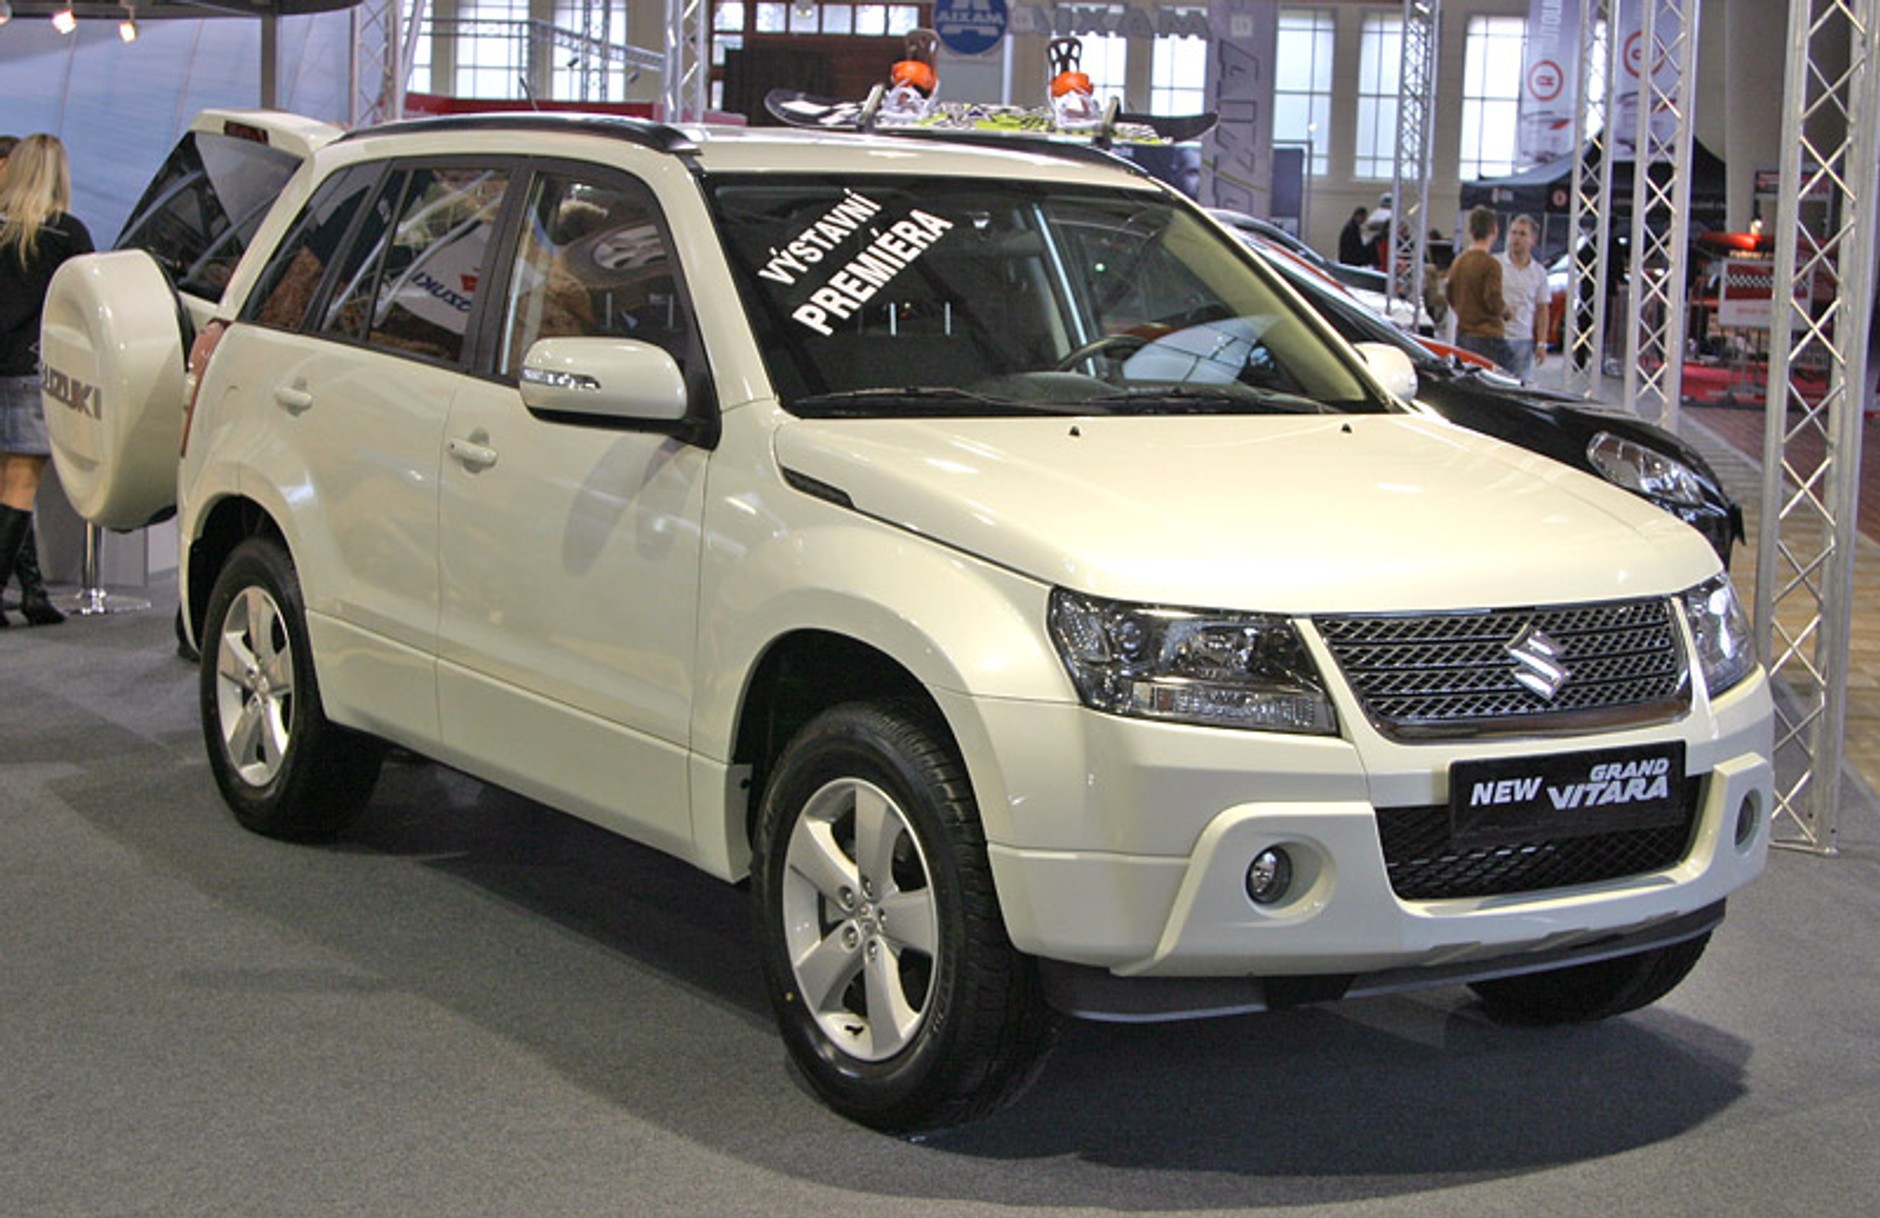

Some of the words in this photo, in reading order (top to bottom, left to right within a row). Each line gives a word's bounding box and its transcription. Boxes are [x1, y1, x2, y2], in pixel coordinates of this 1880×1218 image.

[757, 187, 882, 285] VÝSTAVNÍ
[791, 209, 954, 336] PREMIÉRA
[42, 362, 102, 421] UZUKI
[1470, 777, 1542, 806] NEW
[1547, 776, 1668, 810] VITARA
[1590, 757, 1670, 781] GRAND
